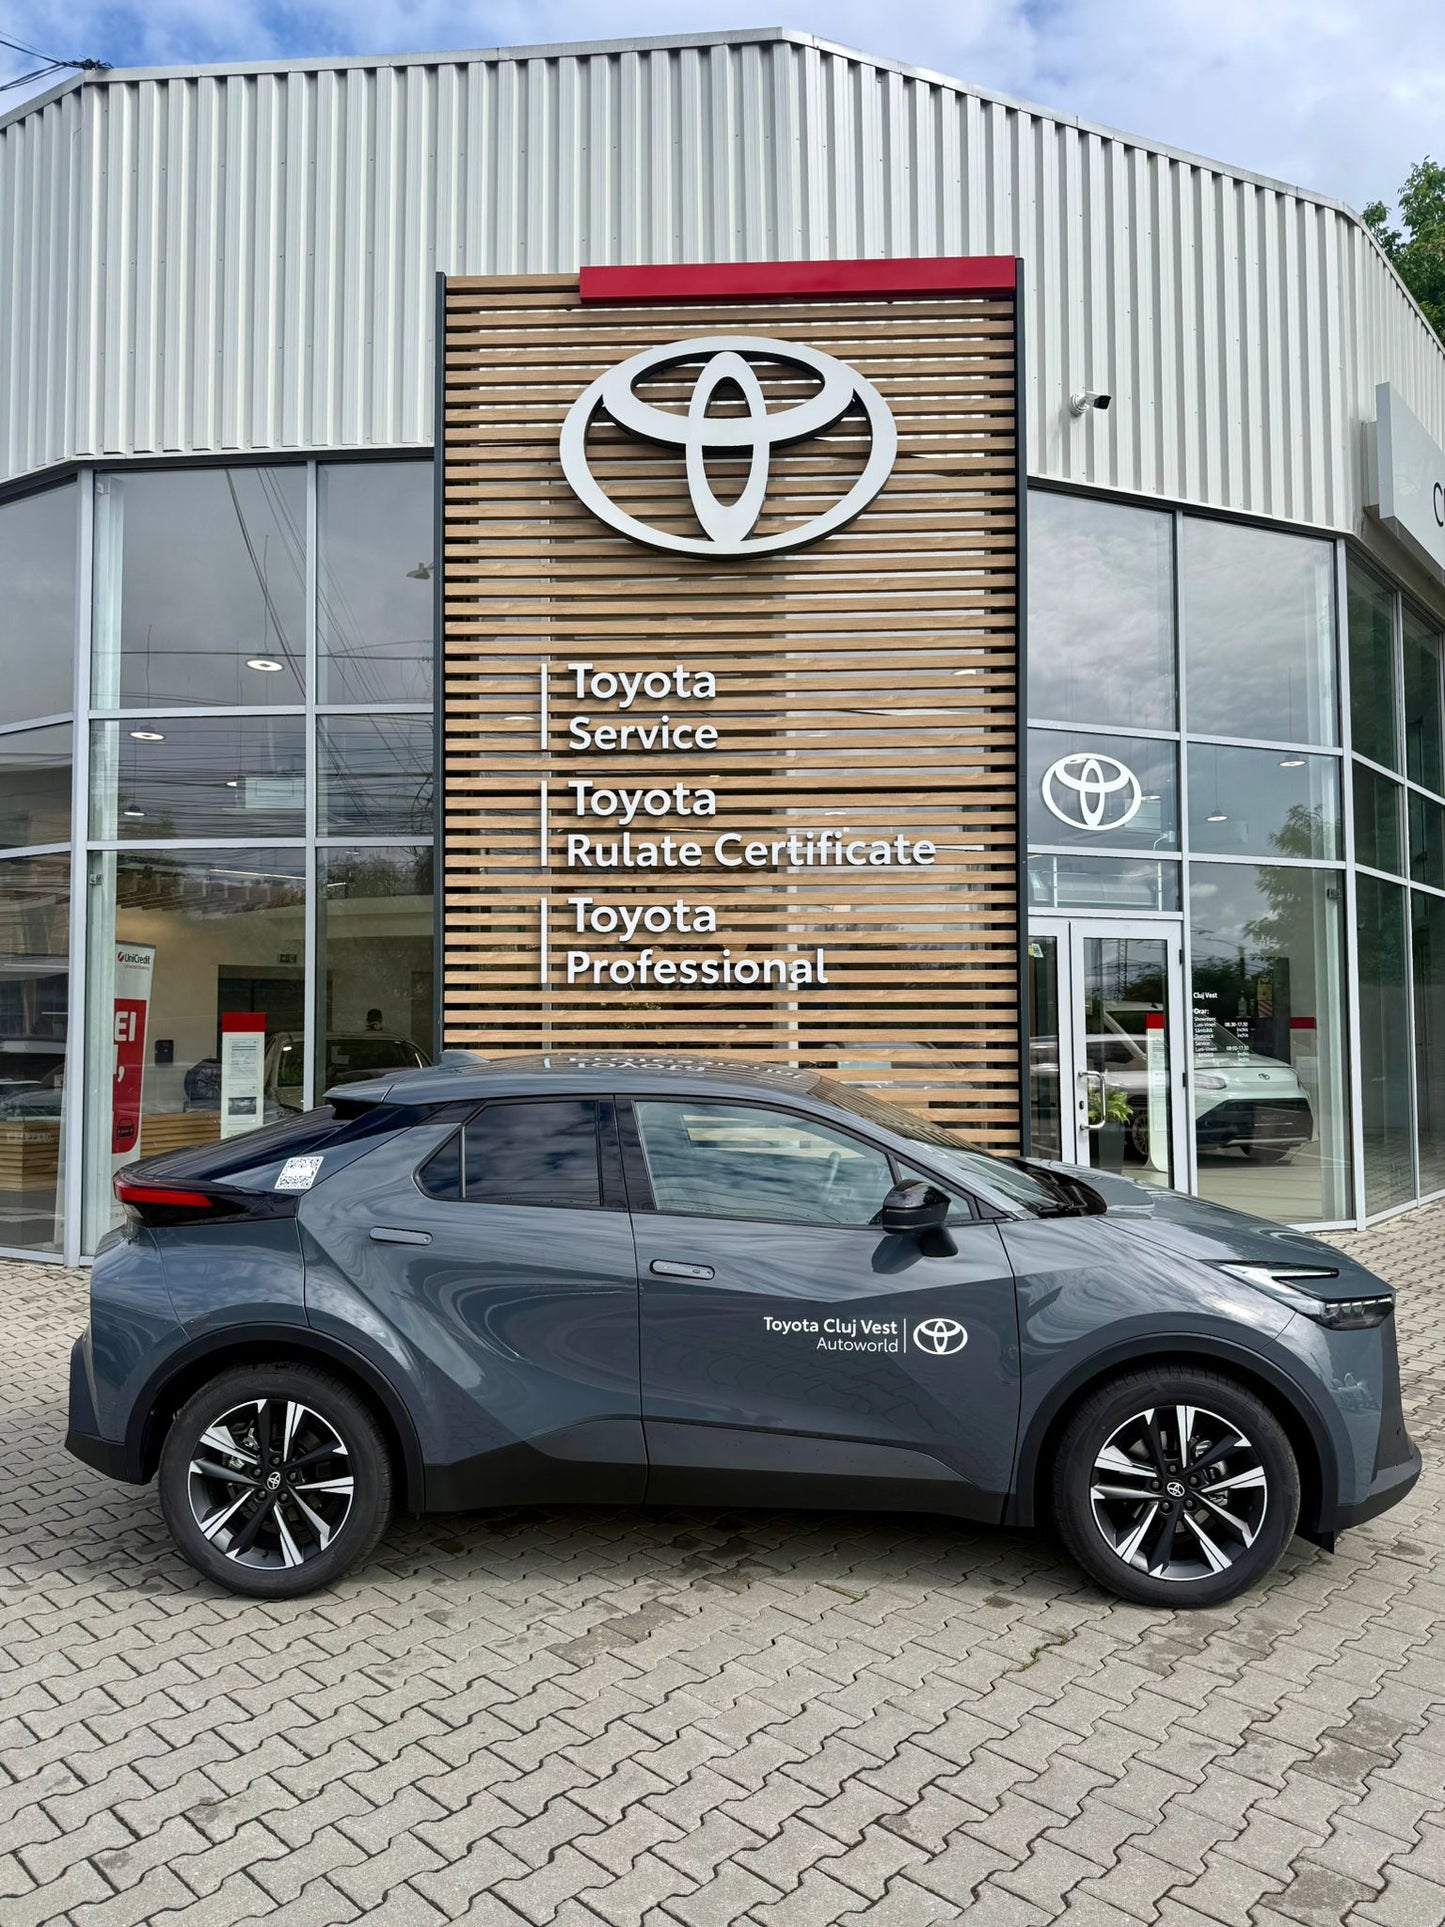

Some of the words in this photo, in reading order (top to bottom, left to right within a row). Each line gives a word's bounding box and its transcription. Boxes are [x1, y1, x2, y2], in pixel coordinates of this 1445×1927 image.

[568, 662, 717, 709] Toyota
[568, 714, 719, 750] Service
[568, 780, 717, 826] Toyota
[567, 832, 702, 867] Rulate
[714, 830, 937, 867] Certificate
[568, 897, 717, 942] Toyota
[124, 953, 151, 965] UniCredit
[567, 948, 829, 984] Professional
[1193, 992, 1205, 1000] Cluj
[763, 1316, 819, 1335] Toyota
[823, 1318, 857, 1337] Cluj
[860, 1319, 898, 1335] Vest
[816, 1337, 898, 1353] Autoworld
